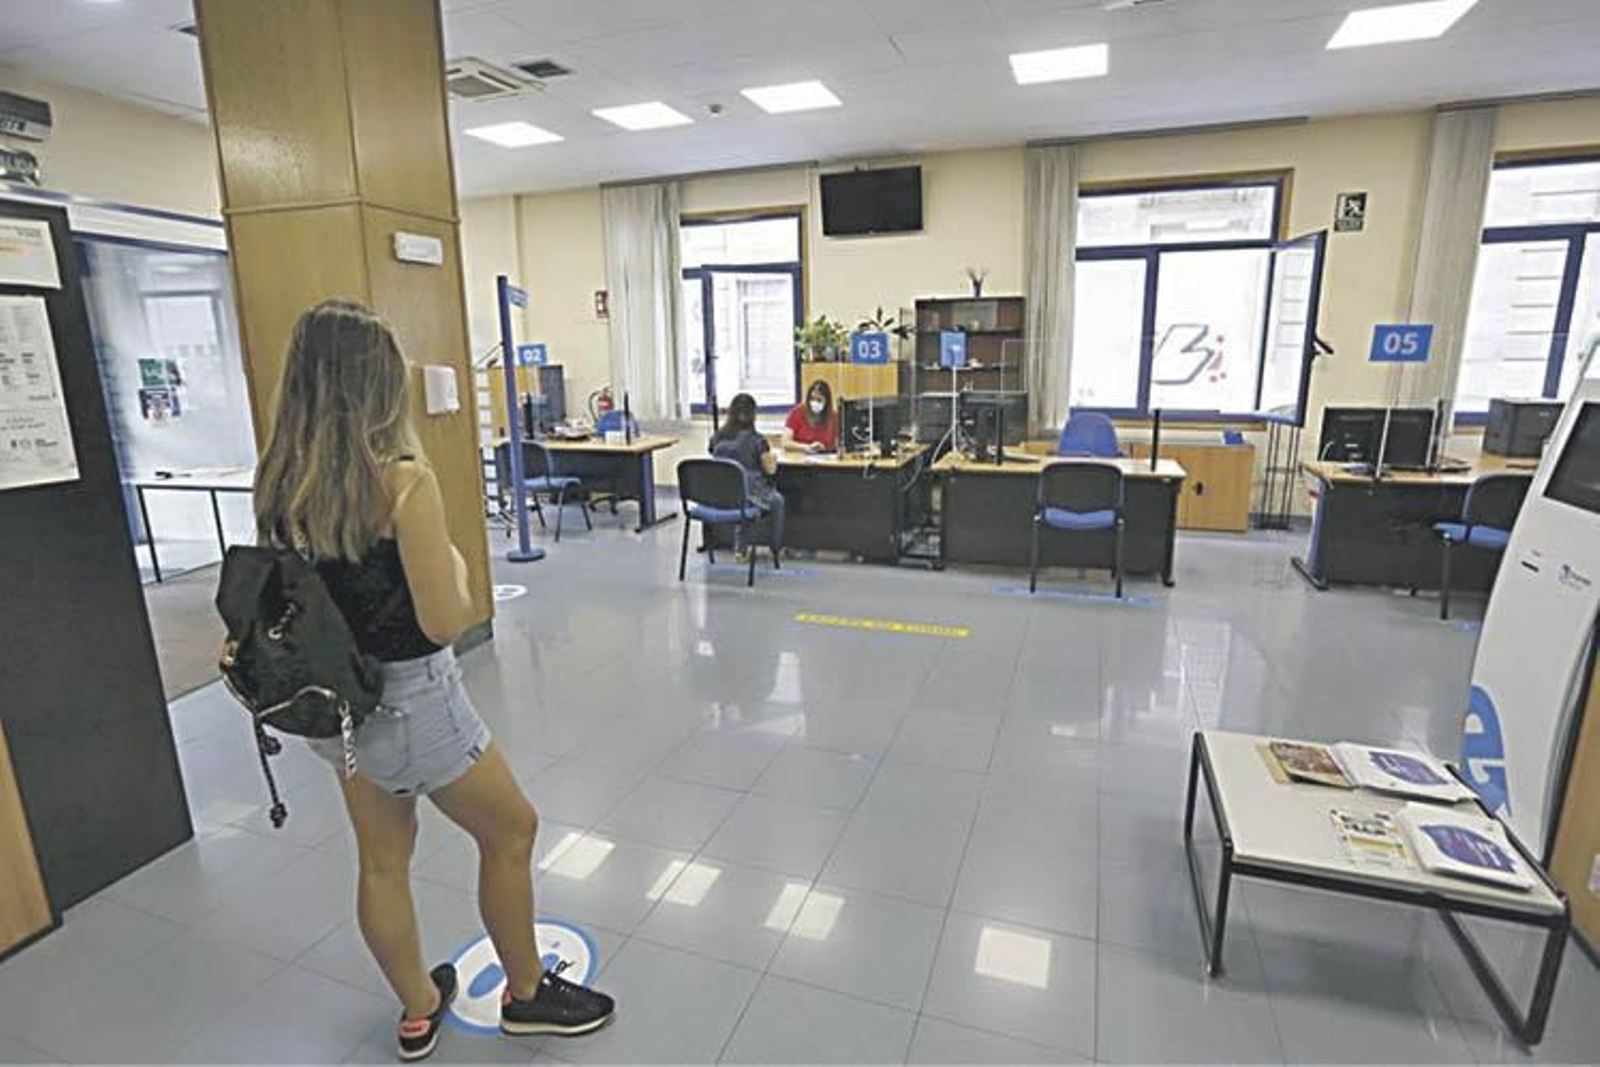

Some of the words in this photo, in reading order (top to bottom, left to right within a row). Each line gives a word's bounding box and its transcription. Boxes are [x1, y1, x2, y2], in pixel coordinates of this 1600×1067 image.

[859, 341, 881, 359] 03
[1383, 332, 1418, 355] 05
[523, 348, 542, 362] 02
